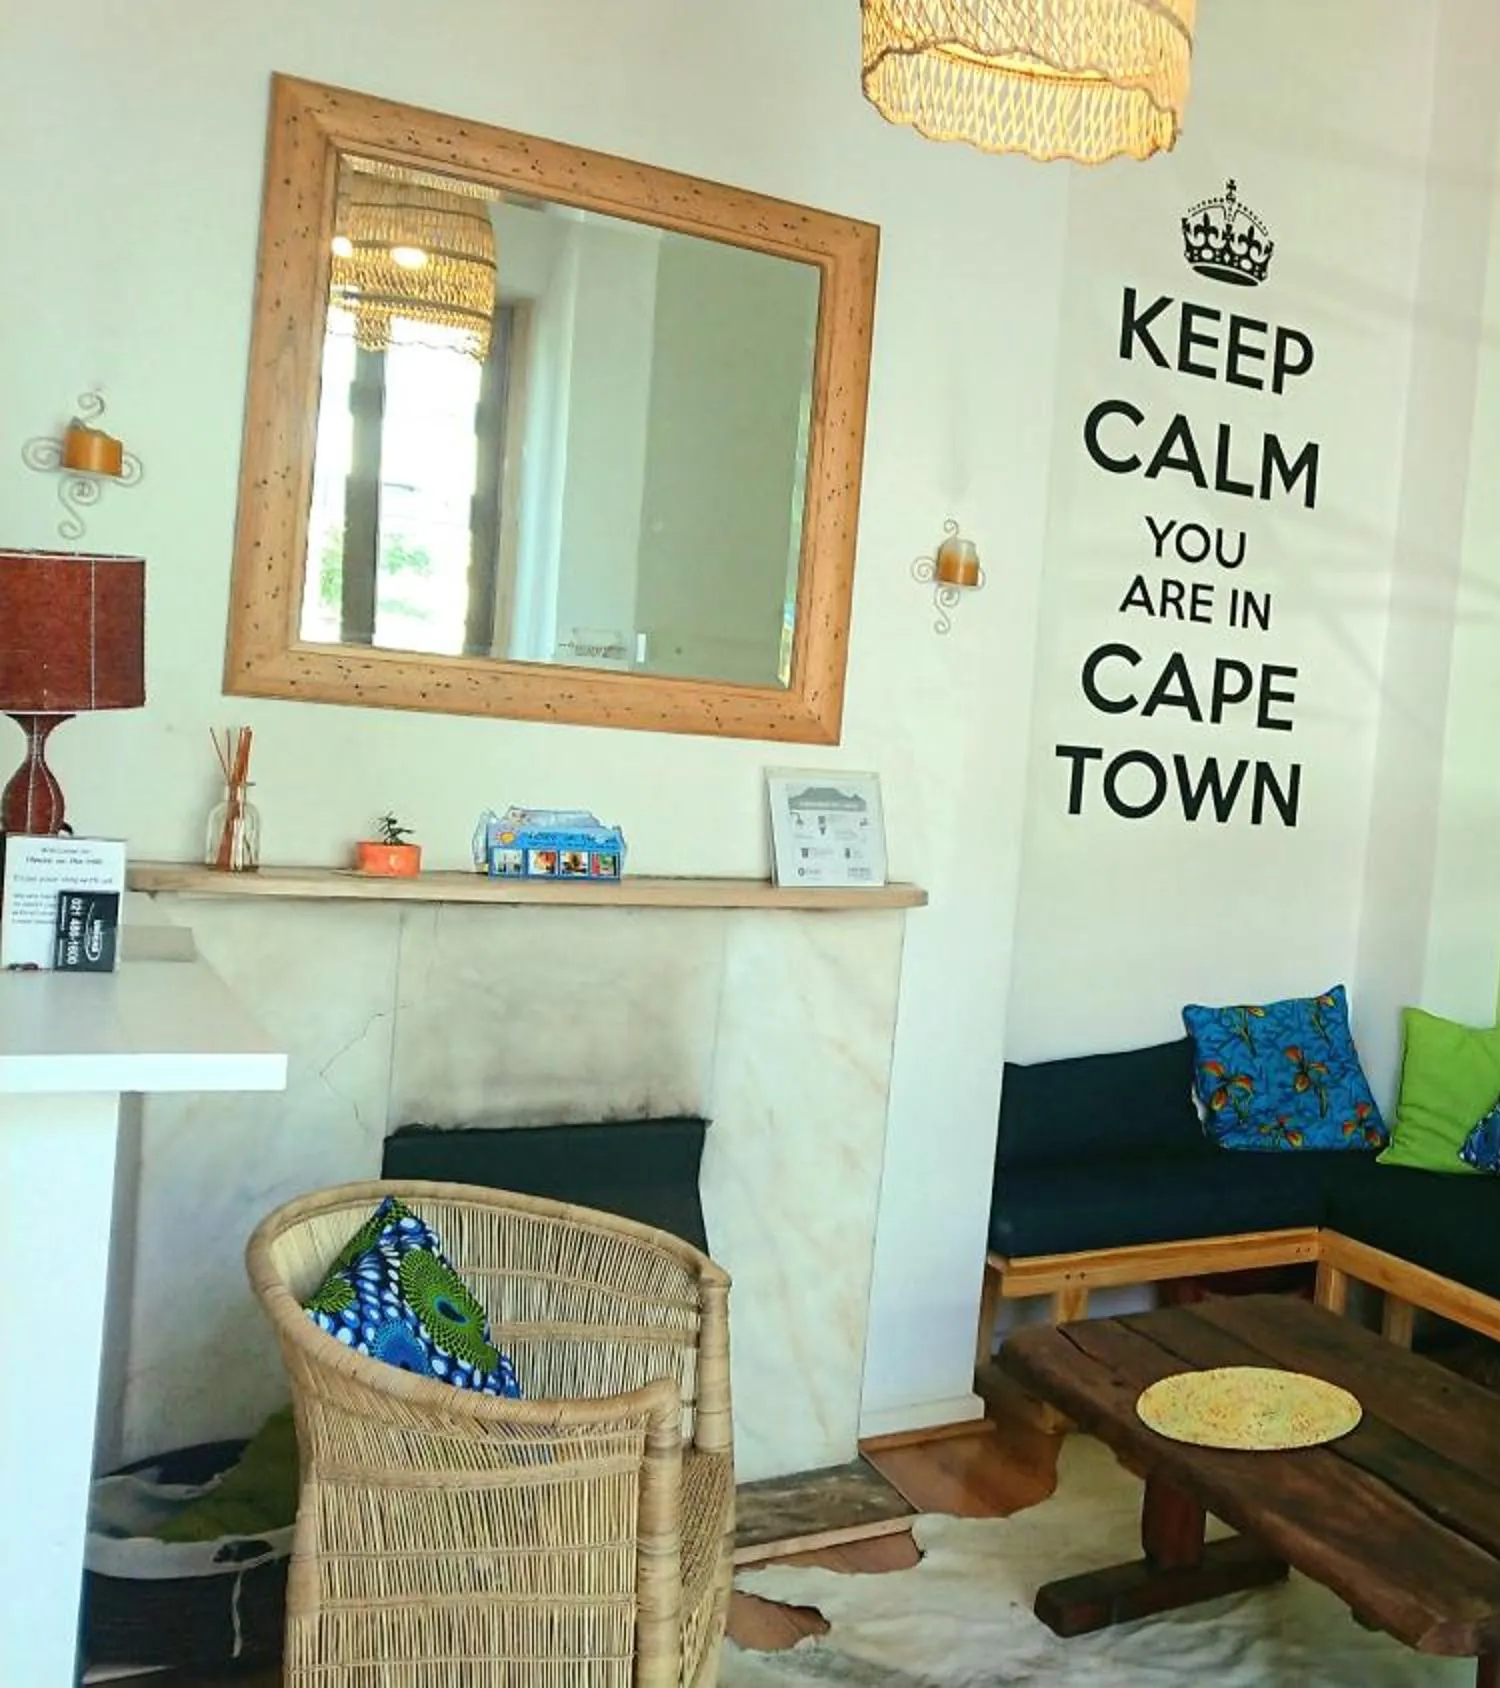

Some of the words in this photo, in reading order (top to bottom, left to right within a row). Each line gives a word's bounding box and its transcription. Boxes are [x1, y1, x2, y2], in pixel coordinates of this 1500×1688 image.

[1119, 287, 1314, 395] KEEP
[1083, 399, 1319, 509] CALM
[1145, 515, 1246, 569] YOU
[1119, 575, 1215, 624] ARE
[1229, 589, 1271, 631] IN
[1081, 643, 1298, 731] CAPE
[1055, 744, 1301, 827] TOWN
